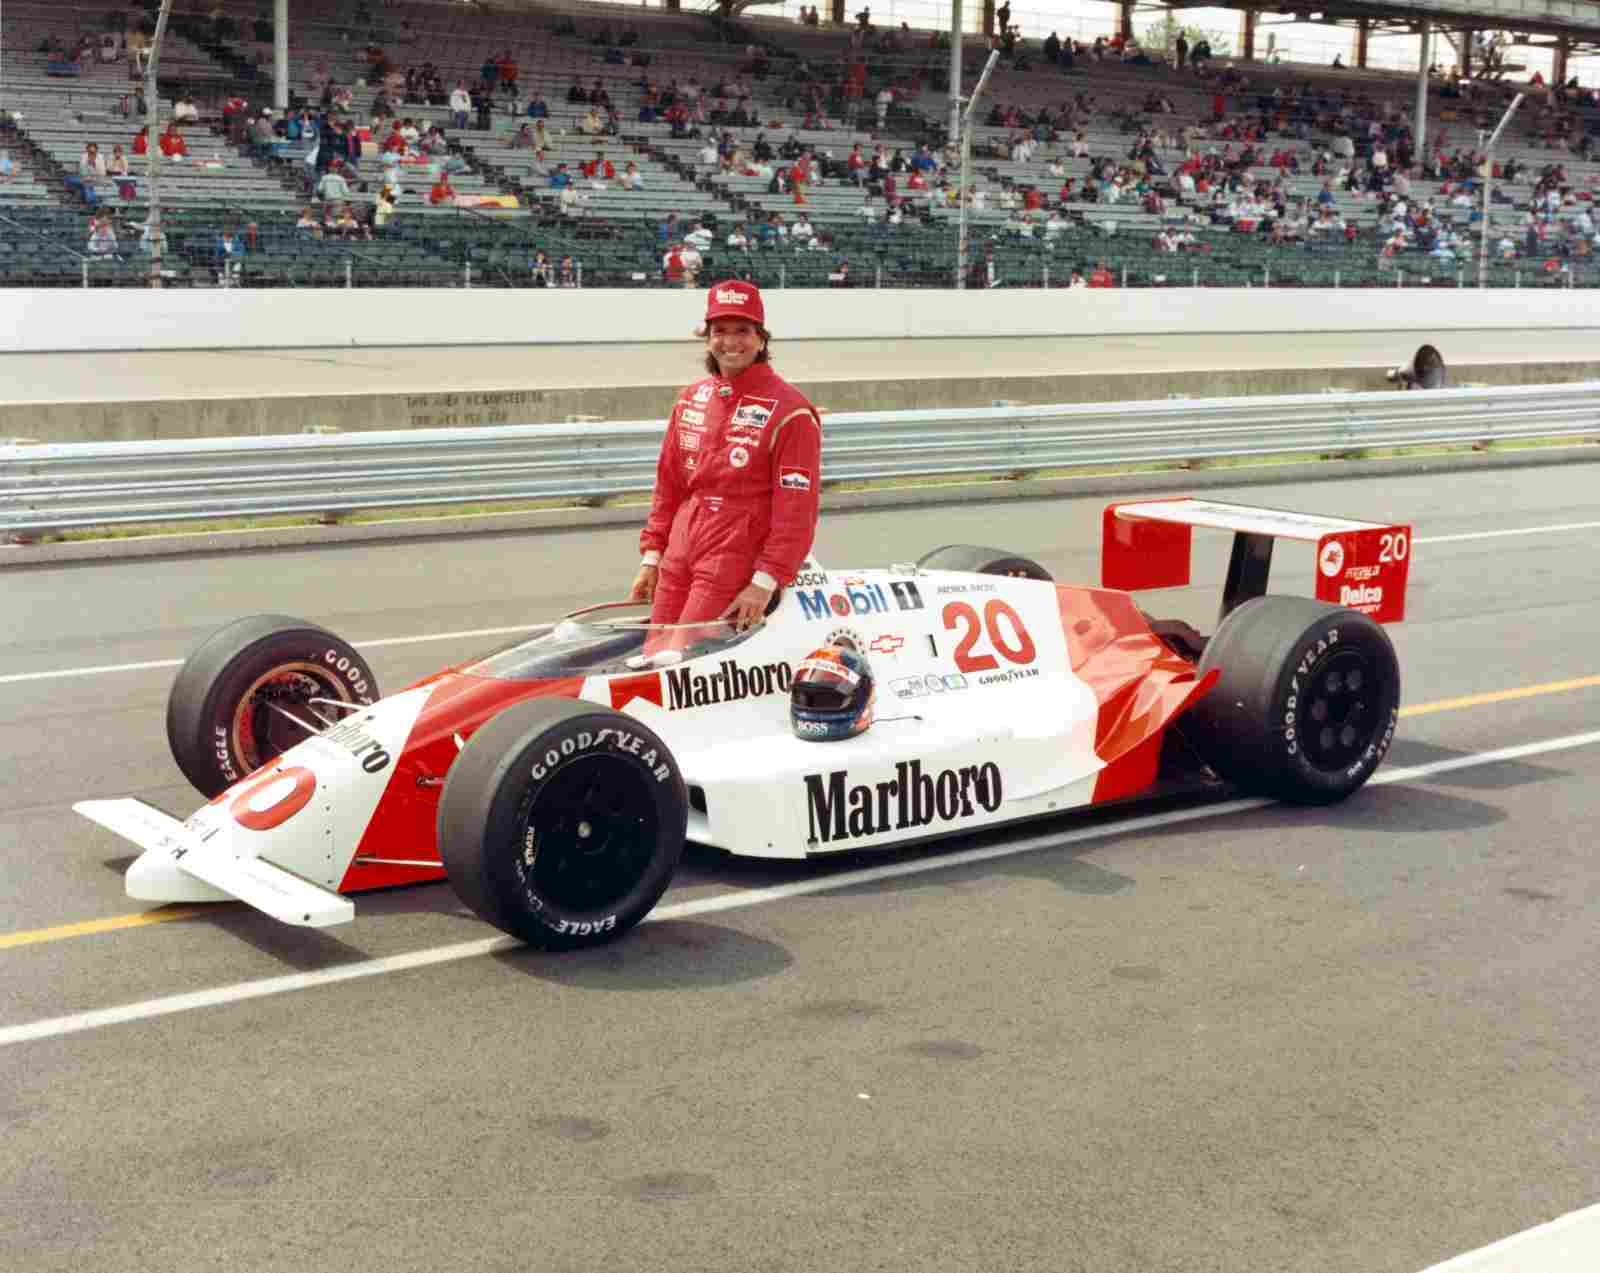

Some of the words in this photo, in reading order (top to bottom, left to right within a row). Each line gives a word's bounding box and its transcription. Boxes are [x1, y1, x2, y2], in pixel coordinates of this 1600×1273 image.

[1379, 533, 1407, 563] 20
[796, 583, 889, 620] Mobil
[1341, 584, 1382, 606] Delco
[942, 598, 1037, 673] 20
[667, 660, 792, 711] Marlboro
[531, 729, 671, 783] GOODYEAR
[804, 760, 1003, 847] Marlboro
[555, 914, 617, 935] EAGLE
